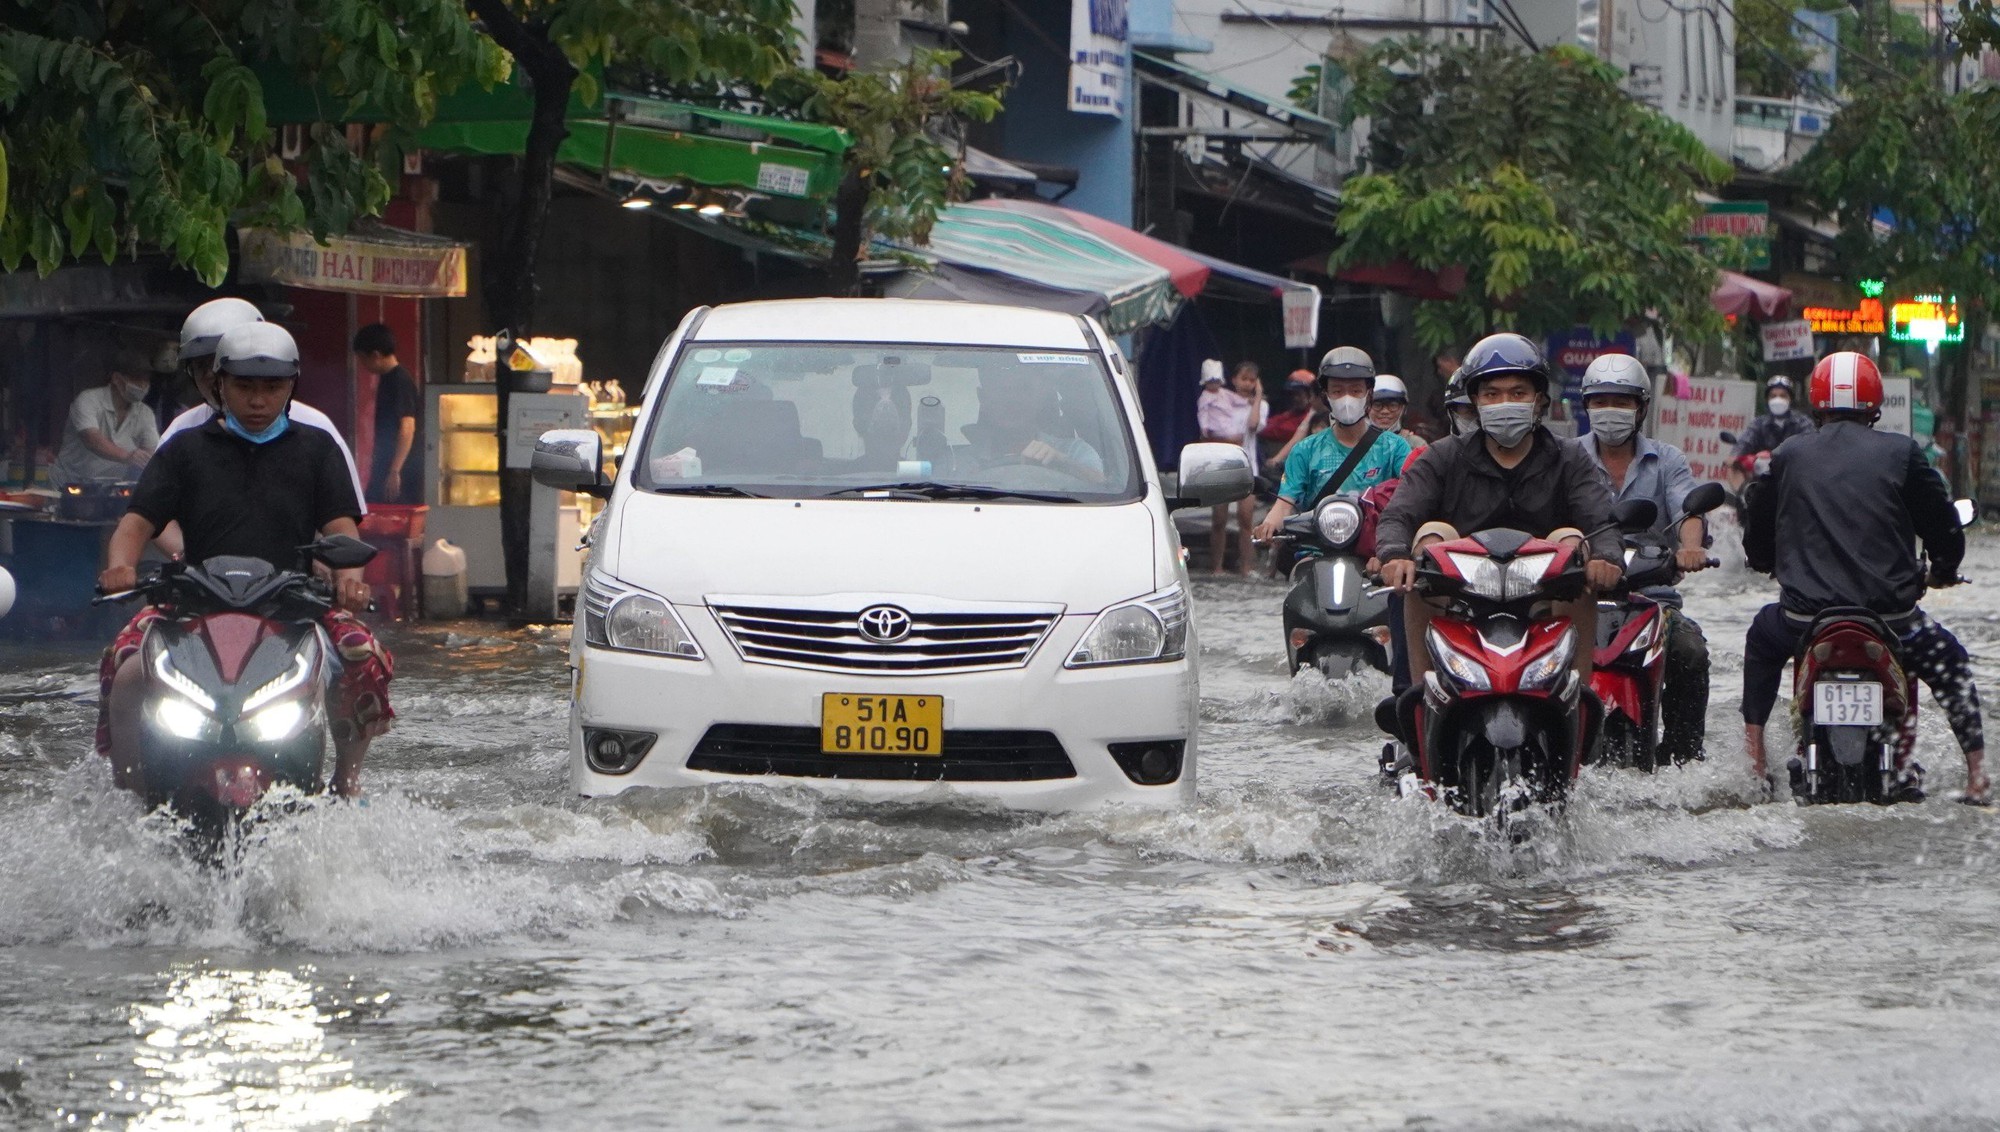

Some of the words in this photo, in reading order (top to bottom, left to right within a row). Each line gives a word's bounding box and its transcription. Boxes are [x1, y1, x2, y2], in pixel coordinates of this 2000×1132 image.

[1824, 684, 1873, 702] 61-L3
[857, 697, 908, 722] 51A
[1825, 703, 1873, 721] 1375
[835, 725, 929, 752] 810.90
